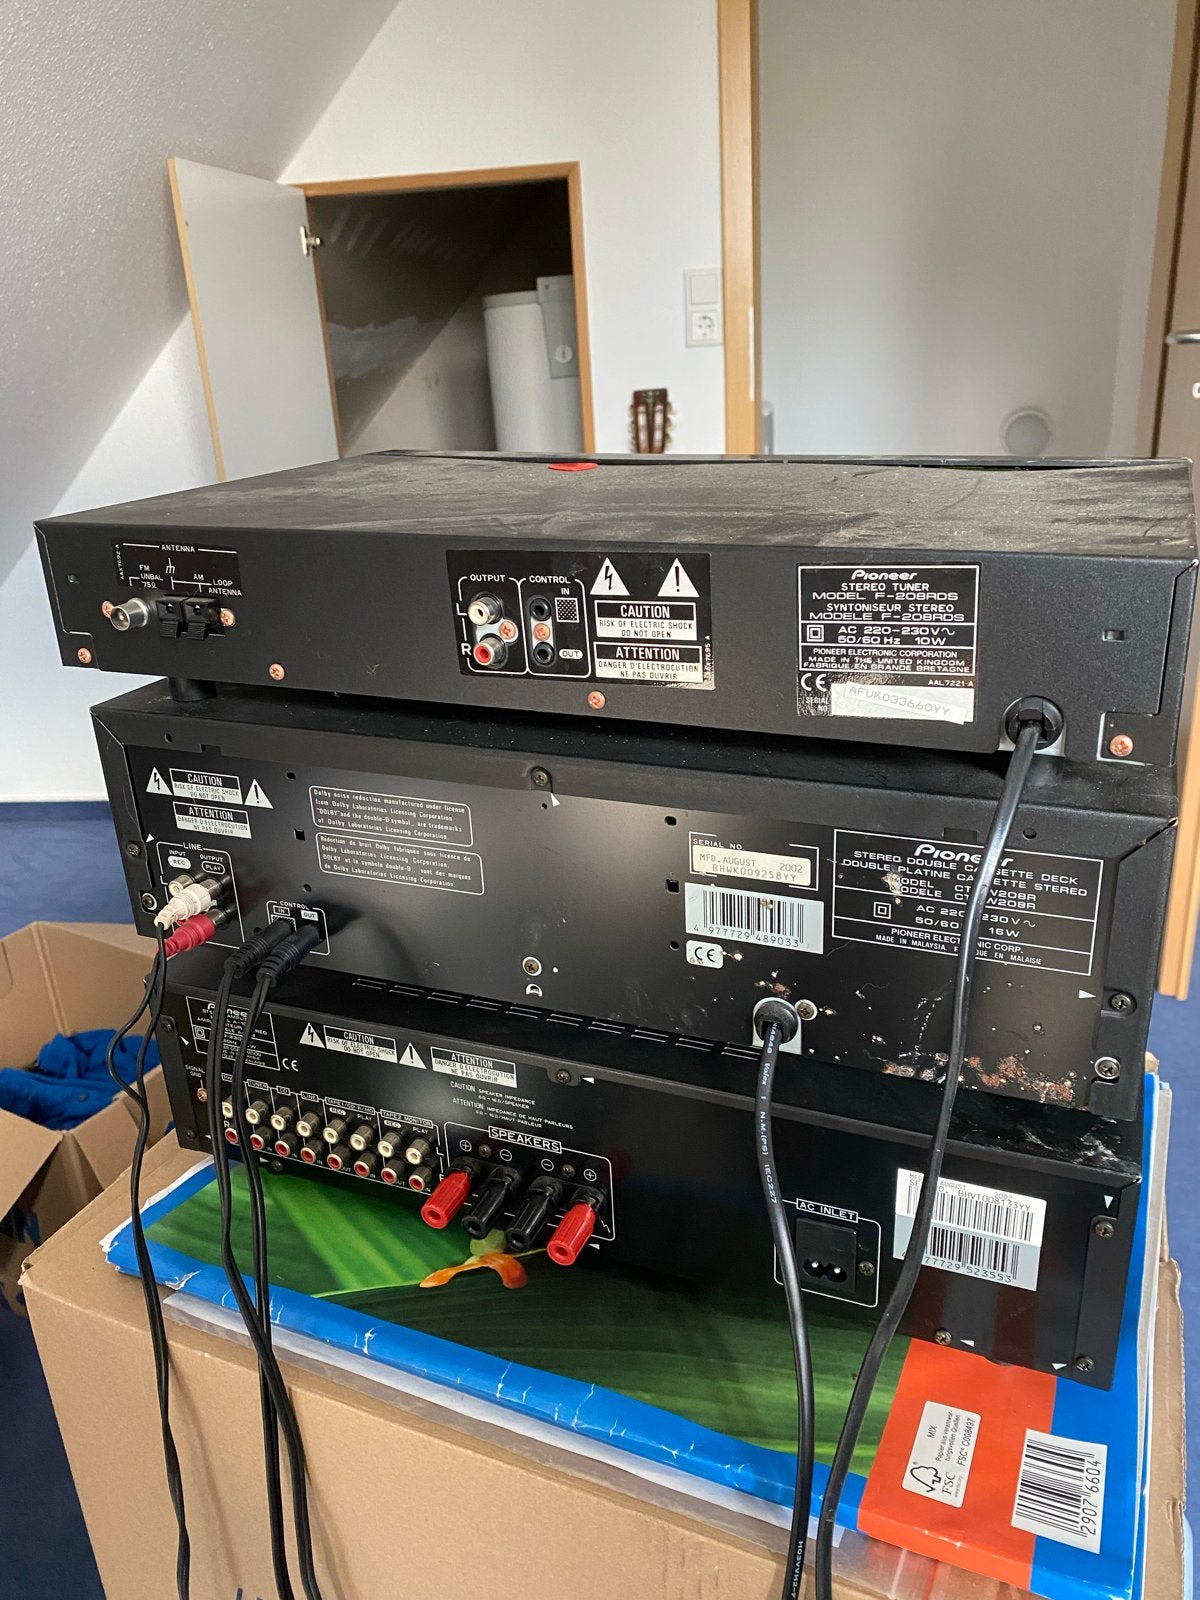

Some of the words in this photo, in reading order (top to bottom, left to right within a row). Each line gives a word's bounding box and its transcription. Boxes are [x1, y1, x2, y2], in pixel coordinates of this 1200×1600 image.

[161, 544, 196, 553] ANTENNA
[140, 572, 164, 582] UNBAL
[193, 573, 204, 581] AM
[469, 574, 506, 582] OUTPUT
[528, 575, 572, 584] CONTROL
[851, 569, 918, 580] Pioneer
[212, 578, 234, 587] LOOP
[841, 583, 886, 592] STEREO
[892, 582, 930, 592] TUNER
[208, 587, 243, 596] ANTENNA
[812, 592, 866, 600] MODEL
[874, 592, 959, 601] F-208RDS
[456, 602, 468, 616] L
[620, 604, 670, 619] CAUTION
[826, 603, 902, 612] SYNTONISEUR
[908, 604, 955, 613] STEREO
[809, 612, 873, 621] MODELE
[881, 613, 966, 622] F-208RDS
[630, 621, 665, 629] ELECTRIC
[668, 622, 693, 630] SHOCK
[837, 626, 857, 634] AC
[837, 636, 881, 645] 50/60
[883, 636, 902, 645] Hz
[914, 637, 947, 646] 10W
[461, 642, 472, 656] R
[615, 646, 680, 661] ATTENTION
[812, 647, 847, 656] PIONEER
[848, 648, 898, 657] ELECTRONIC
[899, 650, 958, 658] CORPORATION
[598, 660, 627, 669] DANGER
[630, 662, 699, 673] D'ELECTROCUTION
[632, 671, 647, 679] PAS
[650, 672, 678, 680] OUVRIR
[805, 697, 830, 705] SERIAL
[848, 685, 951, 716] AFUK033660YY
[187, 773, 222, 787] CAUTION
[196, 786, 220, 794] ELECTRIC
[313, 789, 331, 798] Dolby
[444, 805, 465, 814] license
[188, 806, 234, 822] ATTENTION
[332, 800, 350, 810] Dolby
[390, 808, 417, 818] Licensing
[419, 811, 453, 822] Corporation
[328, 819, 345, 827] Dolby
[385, 826, 412, 836] Licensing
[428, 823, 462, 833] trademarks
[182, 842, 202, 851] LINE
[692, 838, 724, 848] SERIAL
[168, 849, 186, 857] INPUT
[199, 853, 224, 863] OUTPUT
[205, 863, 222, 872] PLAY
[780, 862, 803, 873] 2002
[853, 850, 902, 863] STEREO
[906, 857, 958, 870] DOUBLE
[1041, 873, 1079, 885] DECK
[842, 859, 891, 872] DOUBLE
[897, 866, 951, 880] PLATINE
[1034, 883, 1088, 897] STEREO
[279, 900, 310, 910] CONTROL
[916, 904, 935, 914] AC
[915, 917, 960, 929] 50/60
[988, 927, 1020, 938] 16W
[693, 924, 699, 932] 4
[708, 926, 750, 940] 977729
[755, 934, 800, 948] 489033
[876, 934, 894, 943] MADE
[891, 928, 931, 940] PIONEER
[994, 943, 1024, 954] CORP.
[994, 951, 1004, 959] EN
[1010, 954, 1043, 965] MALAISIE
[343, 1031, 375, 1045] CAUTION
[350, 1041, 376, 1052] ELECTRIC
[434, 1059, 457, 1068] DANGER
[451, 1052, 494, 1069] ATTENTION
[762, 1063, 770, 1086] Volex
[450, 1080, 476, 1092] CAUTION
[478, 1088, 503, 1099] SPEAKER
[504, 1094, 536, 1106] IMPEDANCE
[452, 1097, 484, 1110] ATTENTION
[486, 1106, 517, 1118] IMPEDANCE
[544, 1119, 574, 1130] PARLEURS
[412, 1126, 429, 1134] PLAY
[491, 1128, 560, 1152] SPEAKERS
[764, 1164, 777, 1204] IEC227
[939, 1181, 966, 1190] AUGUST
[994, 1191, 1013, 1200] 2002
[799, 1201, 815, 1211] AC
[820, 1206, 856, 1220] INLET
[966, 1266, 1012, 1284] 523553
[927, 1424, 938, 1439] MIX
[1086, 1460, 1102, 1494] 6604
[942, 1471, 956, 1496] FSC
[1080, 1499, 1099, 1536] 2907
